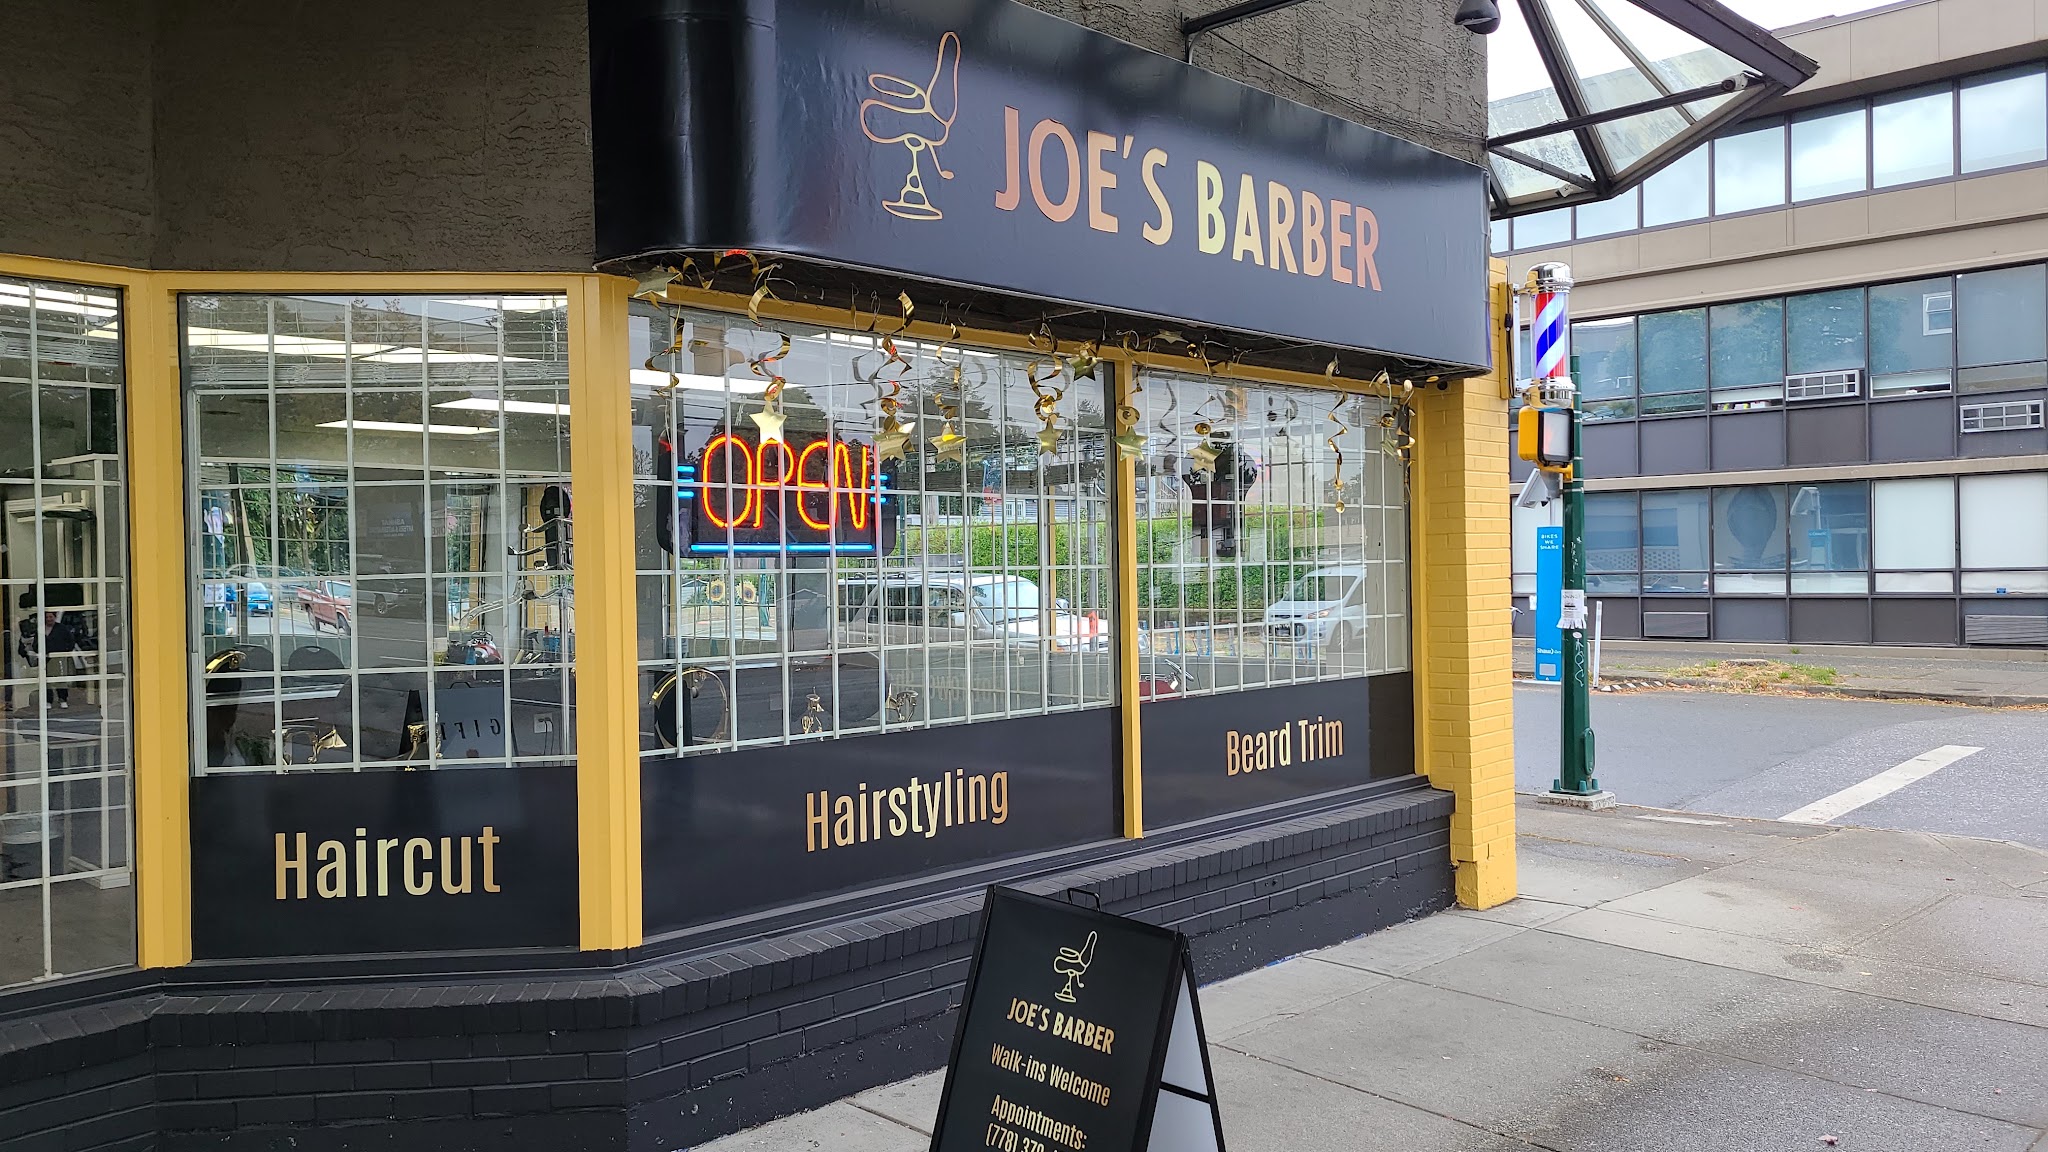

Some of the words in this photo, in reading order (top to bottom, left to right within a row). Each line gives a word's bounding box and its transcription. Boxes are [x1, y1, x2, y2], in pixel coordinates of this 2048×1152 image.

[995, 105, 1174, 246] JOE'S
[1197, 160, 1383, 292] BARBER
[702, 433, 870, 529] OPEN
[1226, 721, 1291, 776] Beard
[1298, 715, 1343, 763] Trim
[806, 768, 1009, 852] Hairstyling
[275, 826, 501, 900] Haircut
[1006, 998, 1051, 1032] JOE'S
[1052, 1011, 1115, 1055] BARBER
[991, 1042, 1047, 1083] Walk-ins
[1049, 1063, 1112, 1107] Welcome
[985, 1122, 1019, 1152] (778)
[991, 1094, 1088, 1150] Appointments:
